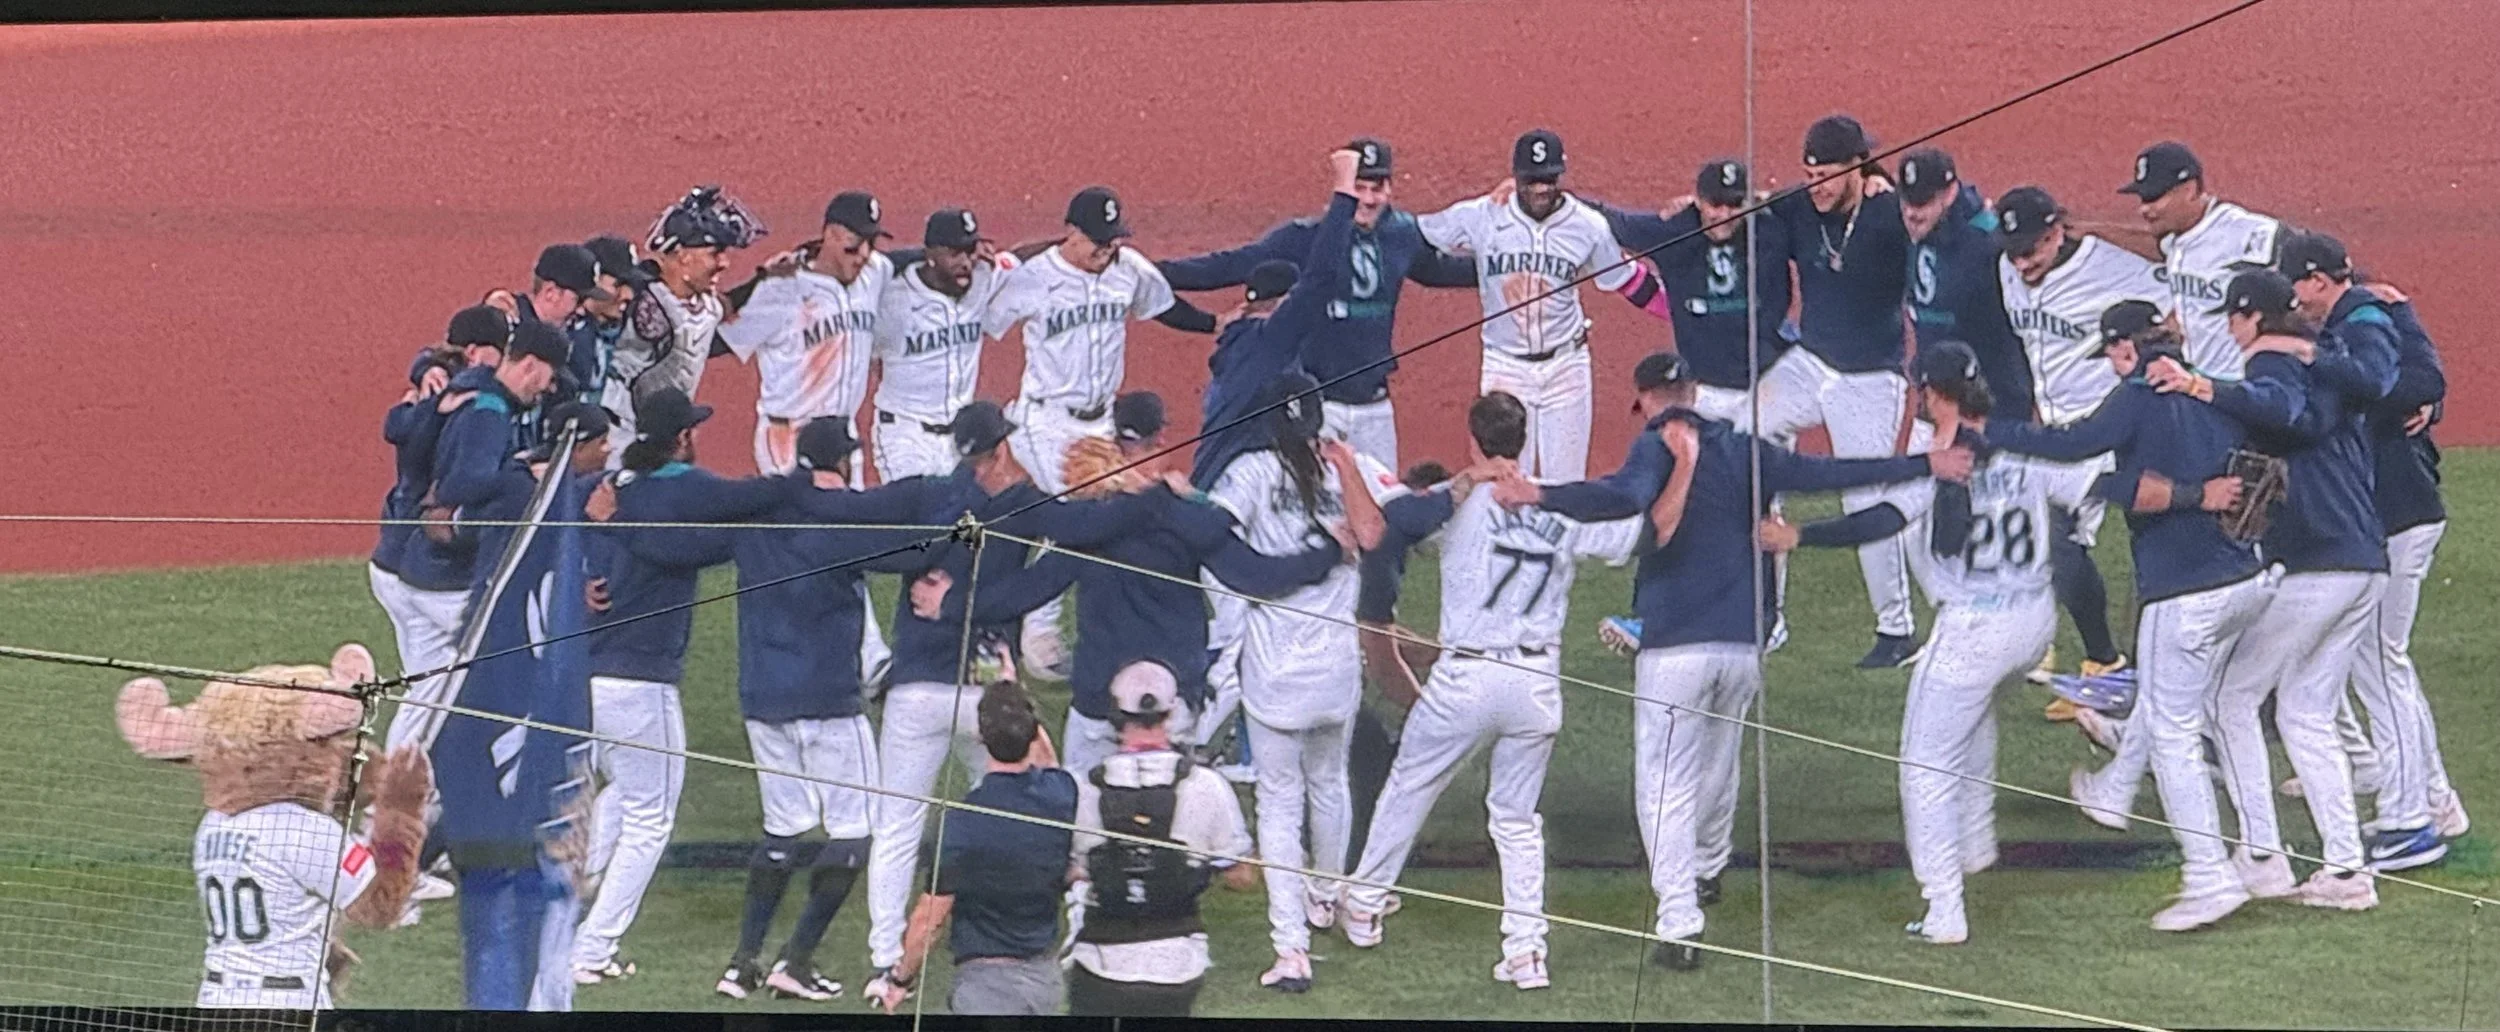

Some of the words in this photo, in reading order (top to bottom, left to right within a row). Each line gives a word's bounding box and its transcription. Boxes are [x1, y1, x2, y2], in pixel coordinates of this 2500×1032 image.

[1363, 144, 1378, 166] S
[1532, 141, 1547, 163] S
[1723, 163, 1736, 186] S
[1105, 200, 1118, 222] S
[1352, 243, 1379, 299] S
[1966, 507, 2034, 573] 28
[1483, 542, 1554, 615] 77
[206, 875, 270, 943] 00
